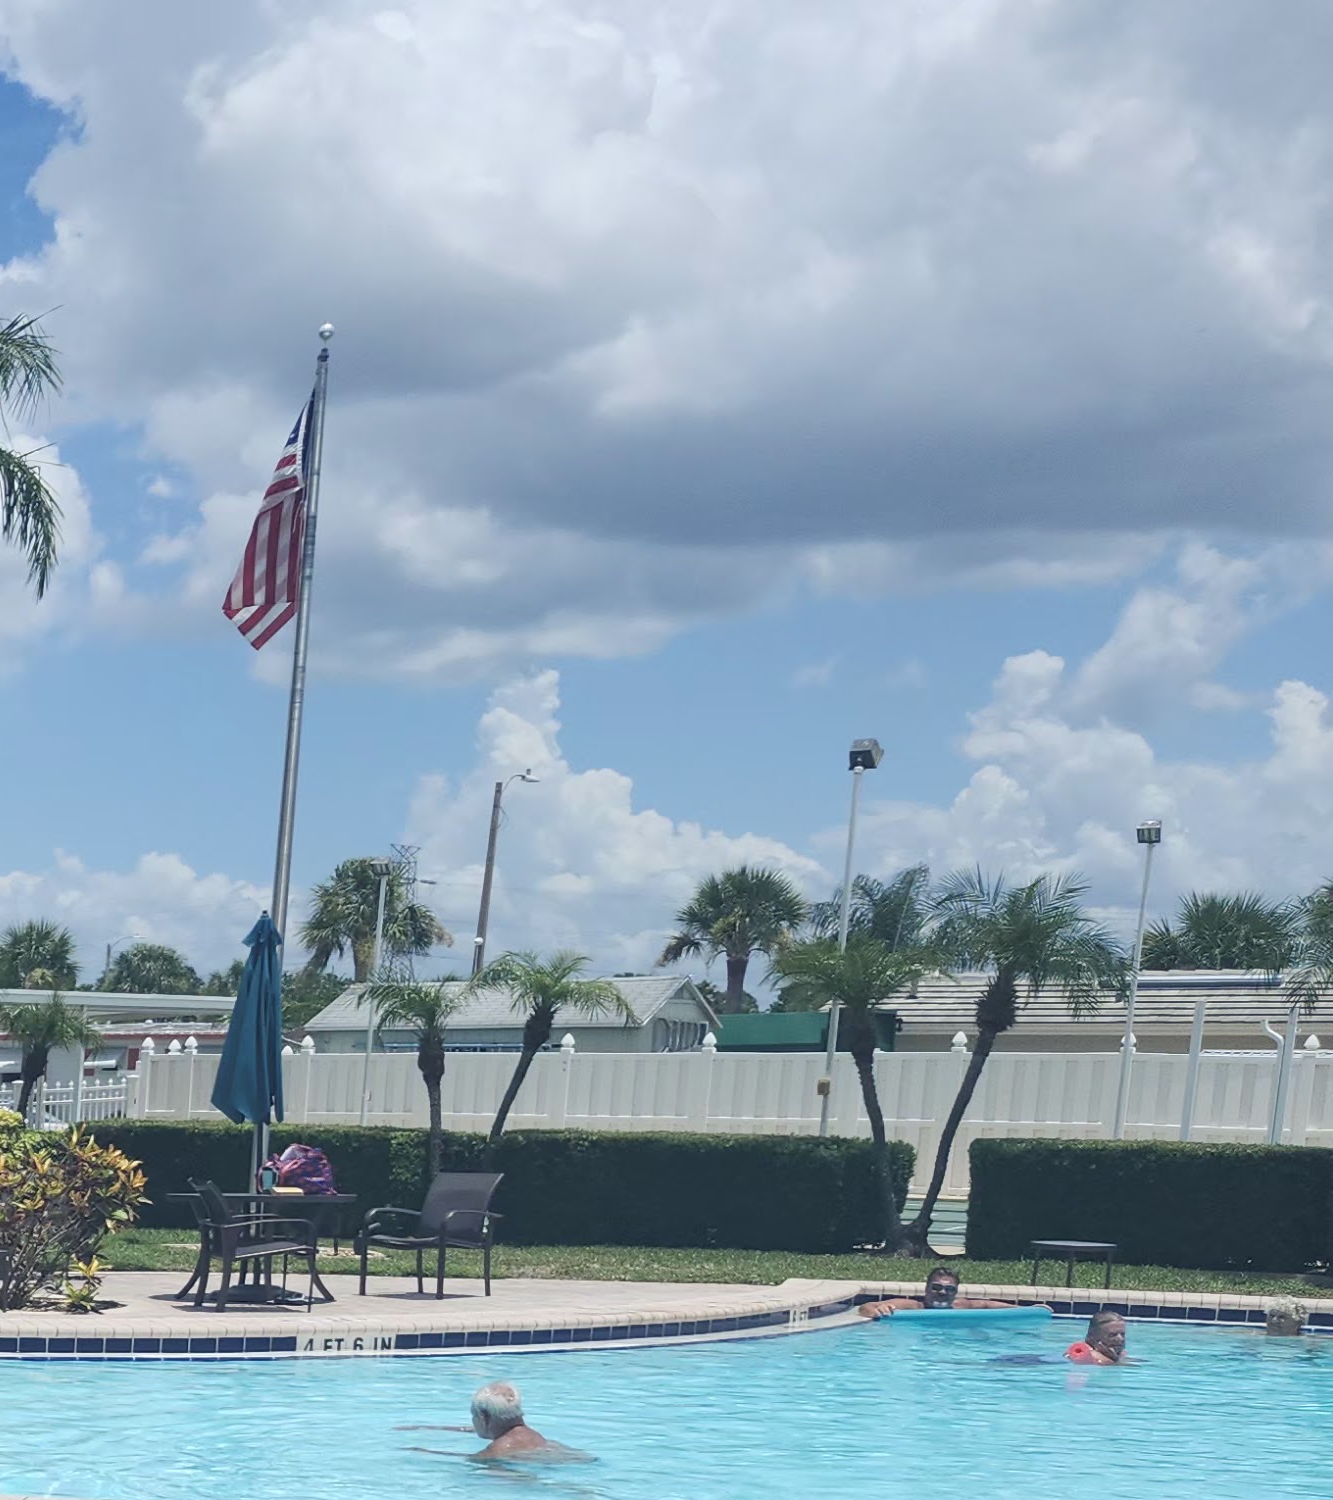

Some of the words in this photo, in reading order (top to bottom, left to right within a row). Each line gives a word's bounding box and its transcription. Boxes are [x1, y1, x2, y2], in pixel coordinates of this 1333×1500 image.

[303, 1338, 314, 1351] 4
[323, 1338, 344, 1351] FT
[353, 1337, 364, 1350] 6
[373, 1337, 392, 1350] IN
